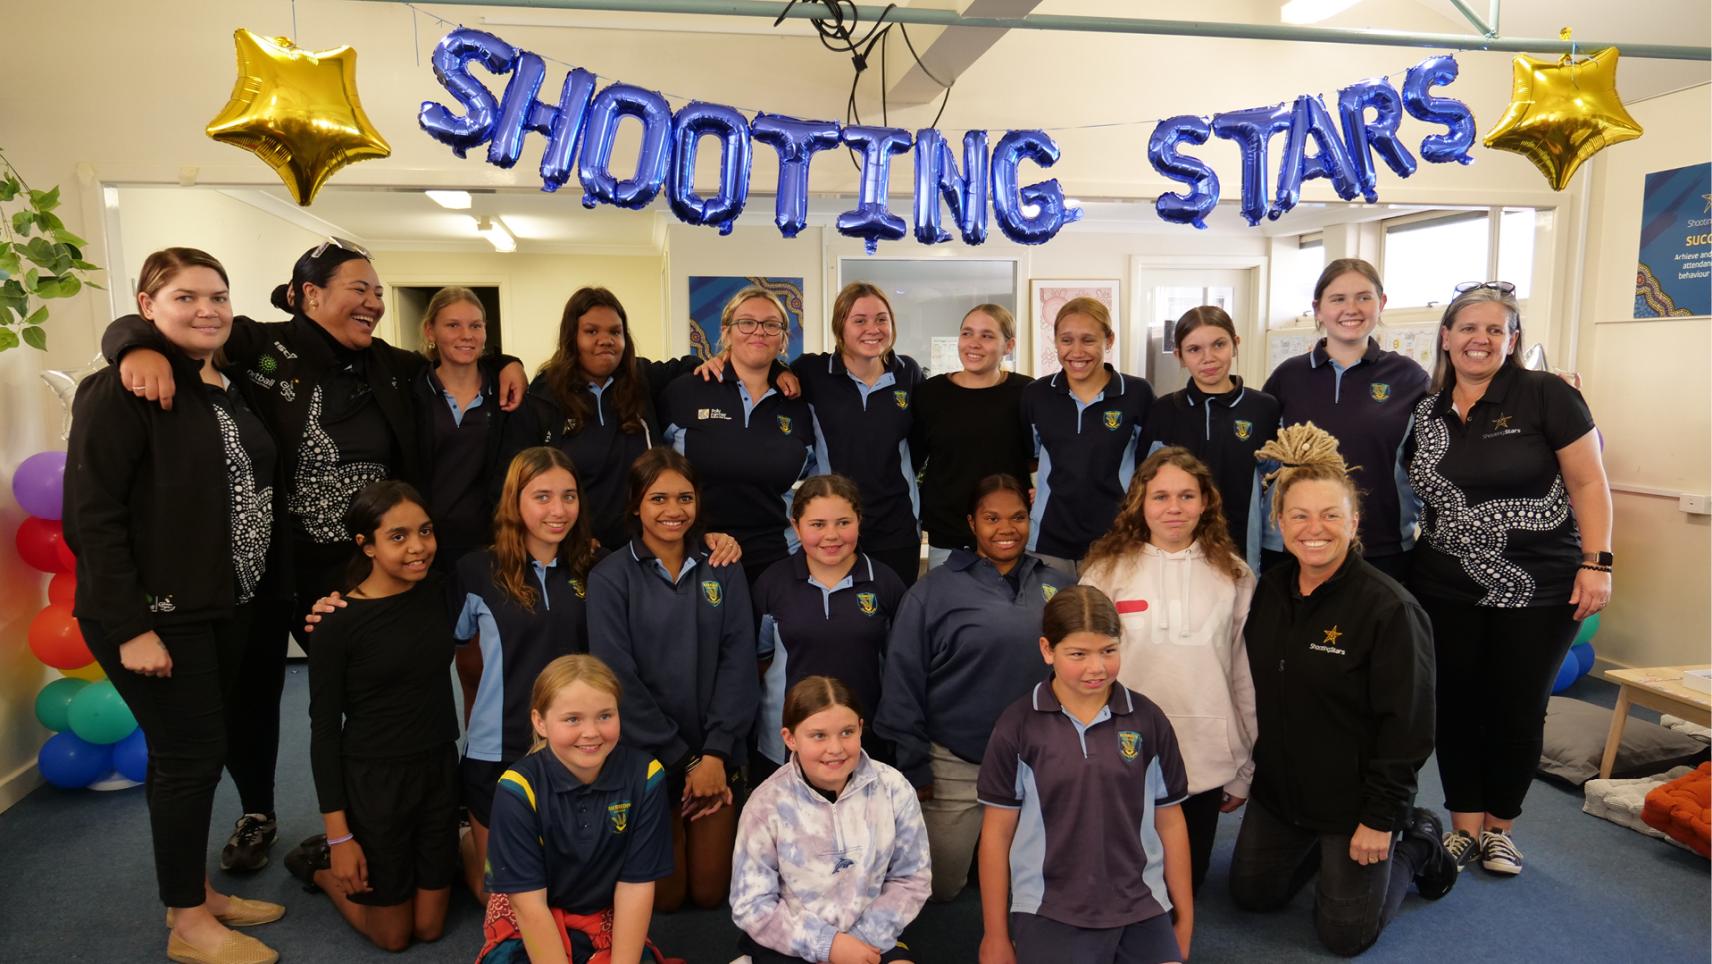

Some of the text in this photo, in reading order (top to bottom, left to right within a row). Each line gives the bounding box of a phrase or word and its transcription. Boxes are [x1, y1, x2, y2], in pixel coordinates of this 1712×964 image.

[418, 25, 1478, 256] SHOOTING STARS
[1679, 271, 1710, 279] behaviour
